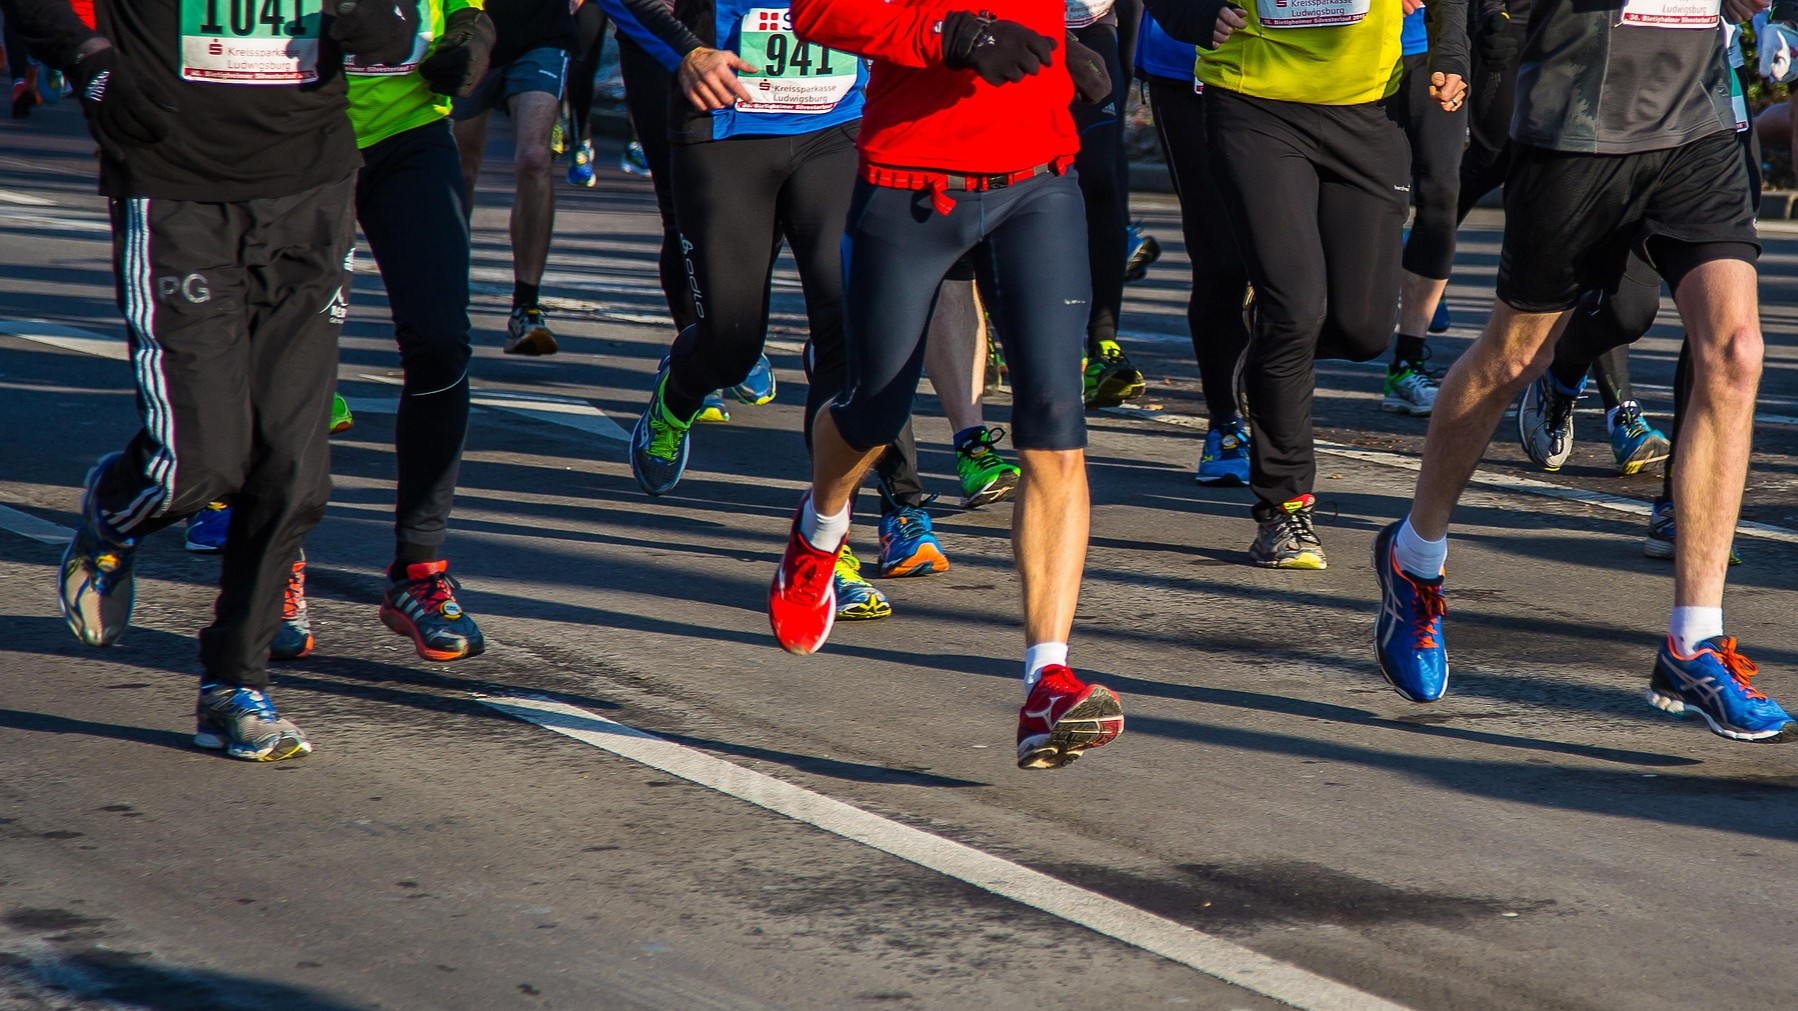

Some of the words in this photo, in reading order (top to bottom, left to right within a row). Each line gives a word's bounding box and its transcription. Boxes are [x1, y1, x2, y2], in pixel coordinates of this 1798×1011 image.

[1291, 7, 1345, 18] Ludwigsburg
[1662, 5, 1707, 15] Ludwigsburg
[200, 0, 306, 36] 1041
[228, 48, 300, 58] Kreissparkasse
[765, 33, 833, 76] 941
[228, 61, 291, 72] Ludwigsburg
[774, 84, 837, 93] Kreissparkasse
[773, 94, 828, 104] Ludwigsburg
[158, 274, 210, 304] PG
